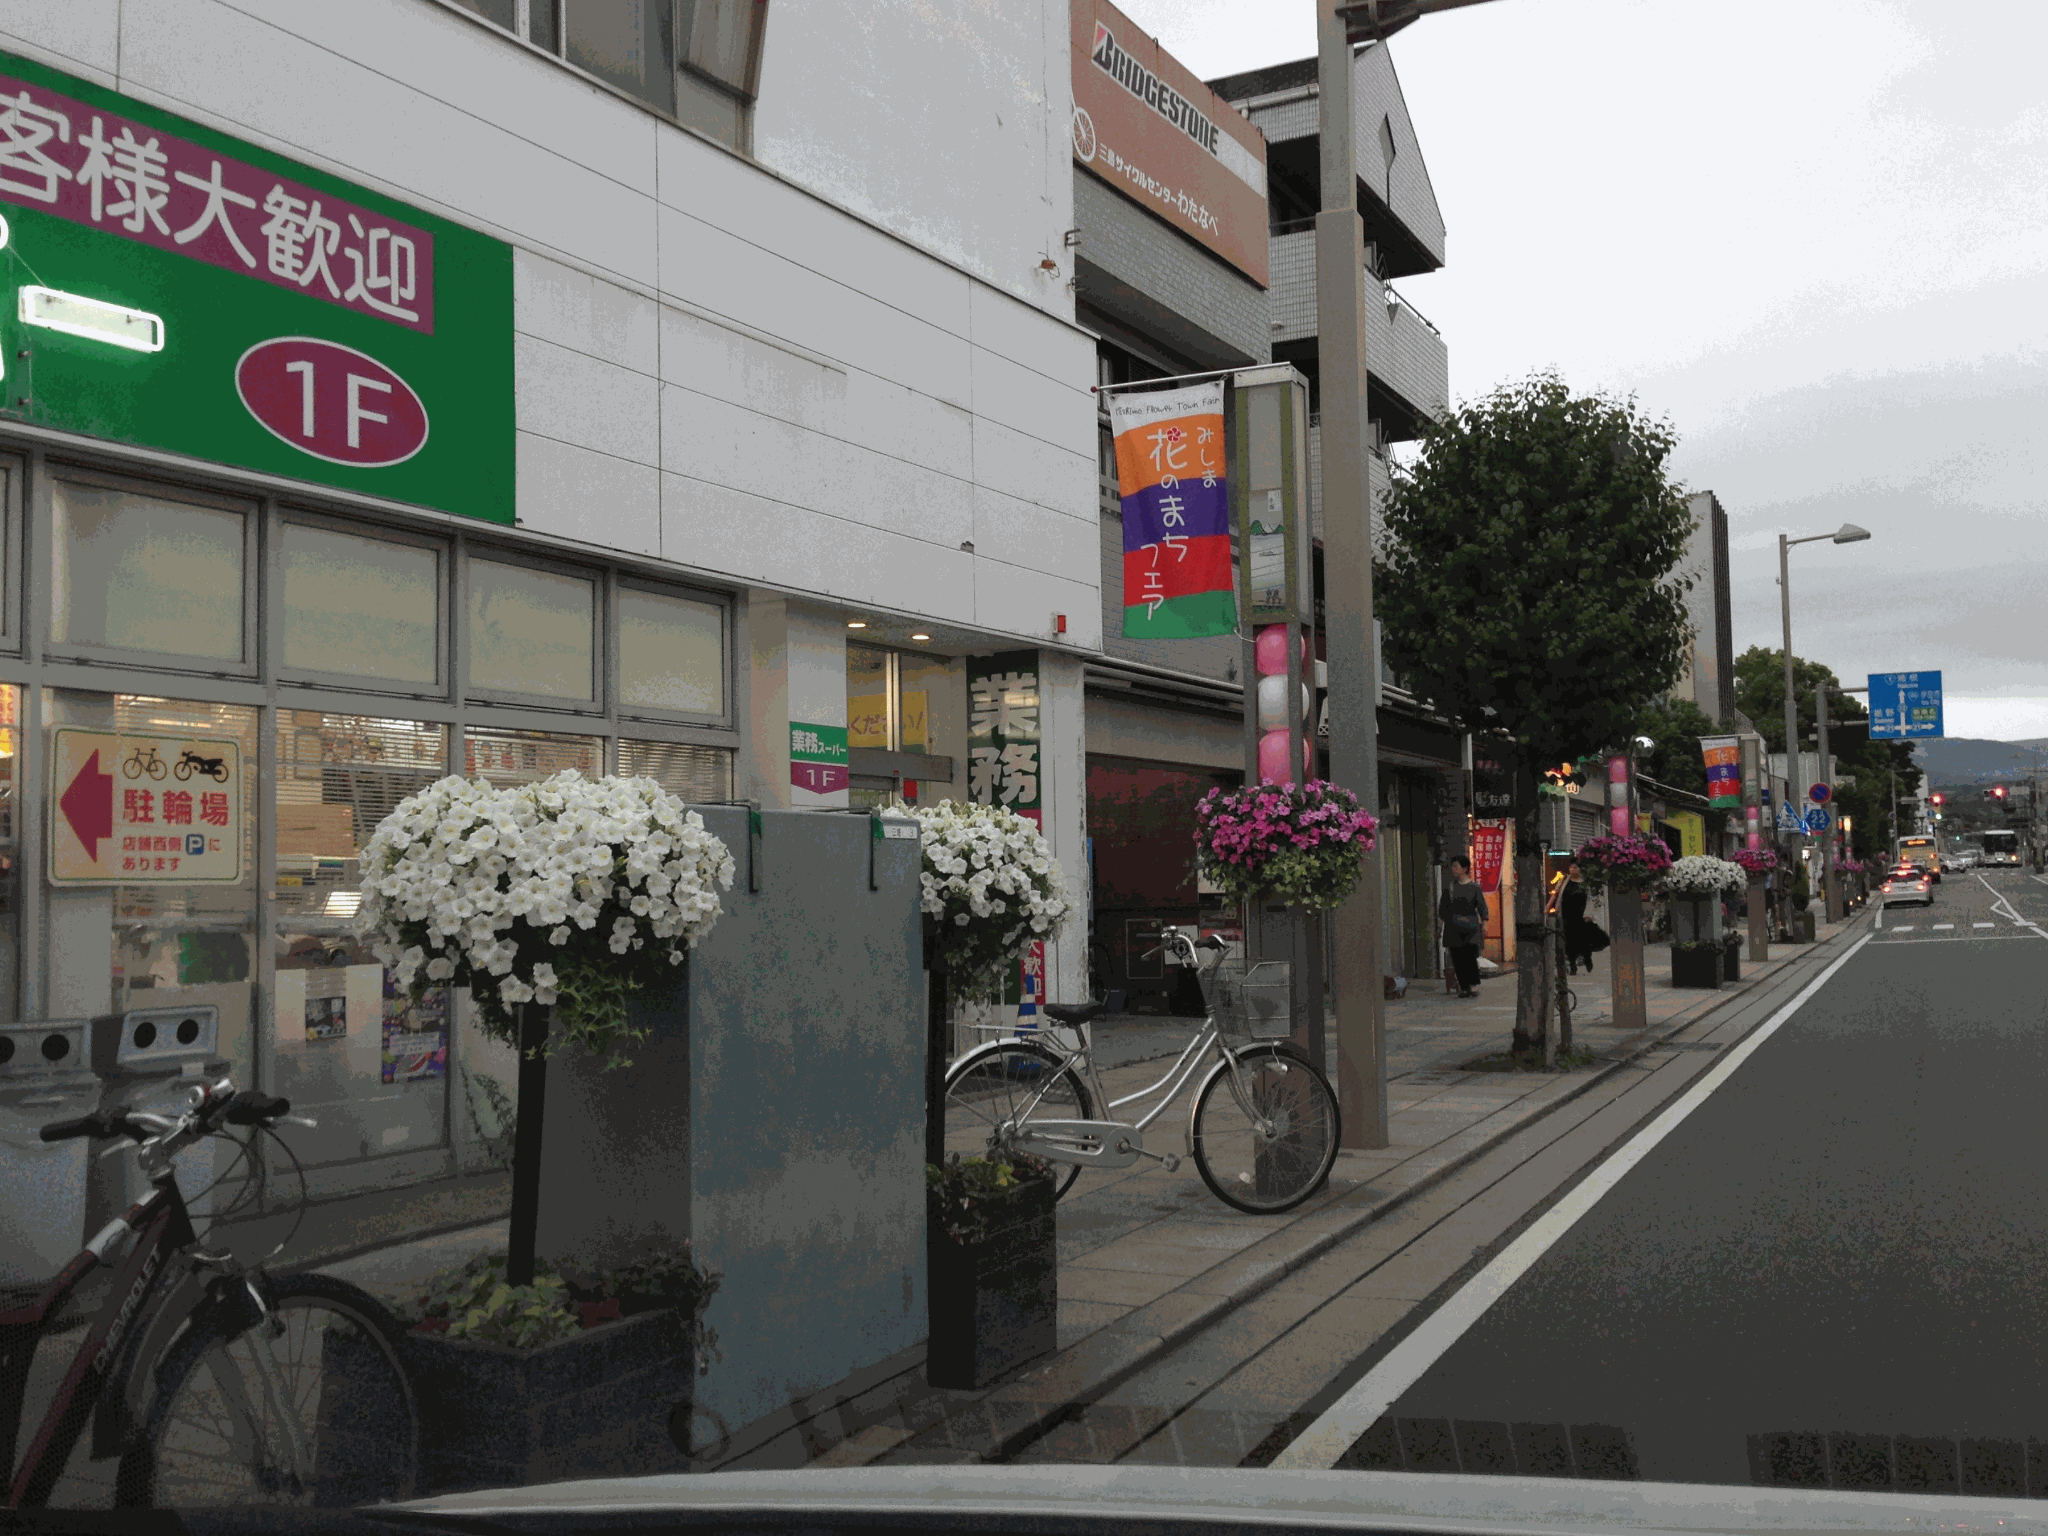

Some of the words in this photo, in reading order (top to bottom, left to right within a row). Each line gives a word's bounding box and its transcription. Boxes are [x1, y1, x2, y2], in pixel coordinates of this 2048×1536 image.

[1092, 19, 1219, 156] BRIDGESTONE
[286, 359, 393, 449] 1F
[1196, 426, 1217, 488] みしま
[1146, 427, 1190, 562] 花のまち
[791, 729, 847, 756] 業務スーパー
[806, 769, 836, 787] 1F
[122, 788, 229, 827] 駐輪場
[1811, 814, 1826, 823] 22
[122, 857, 181, 872] あります
